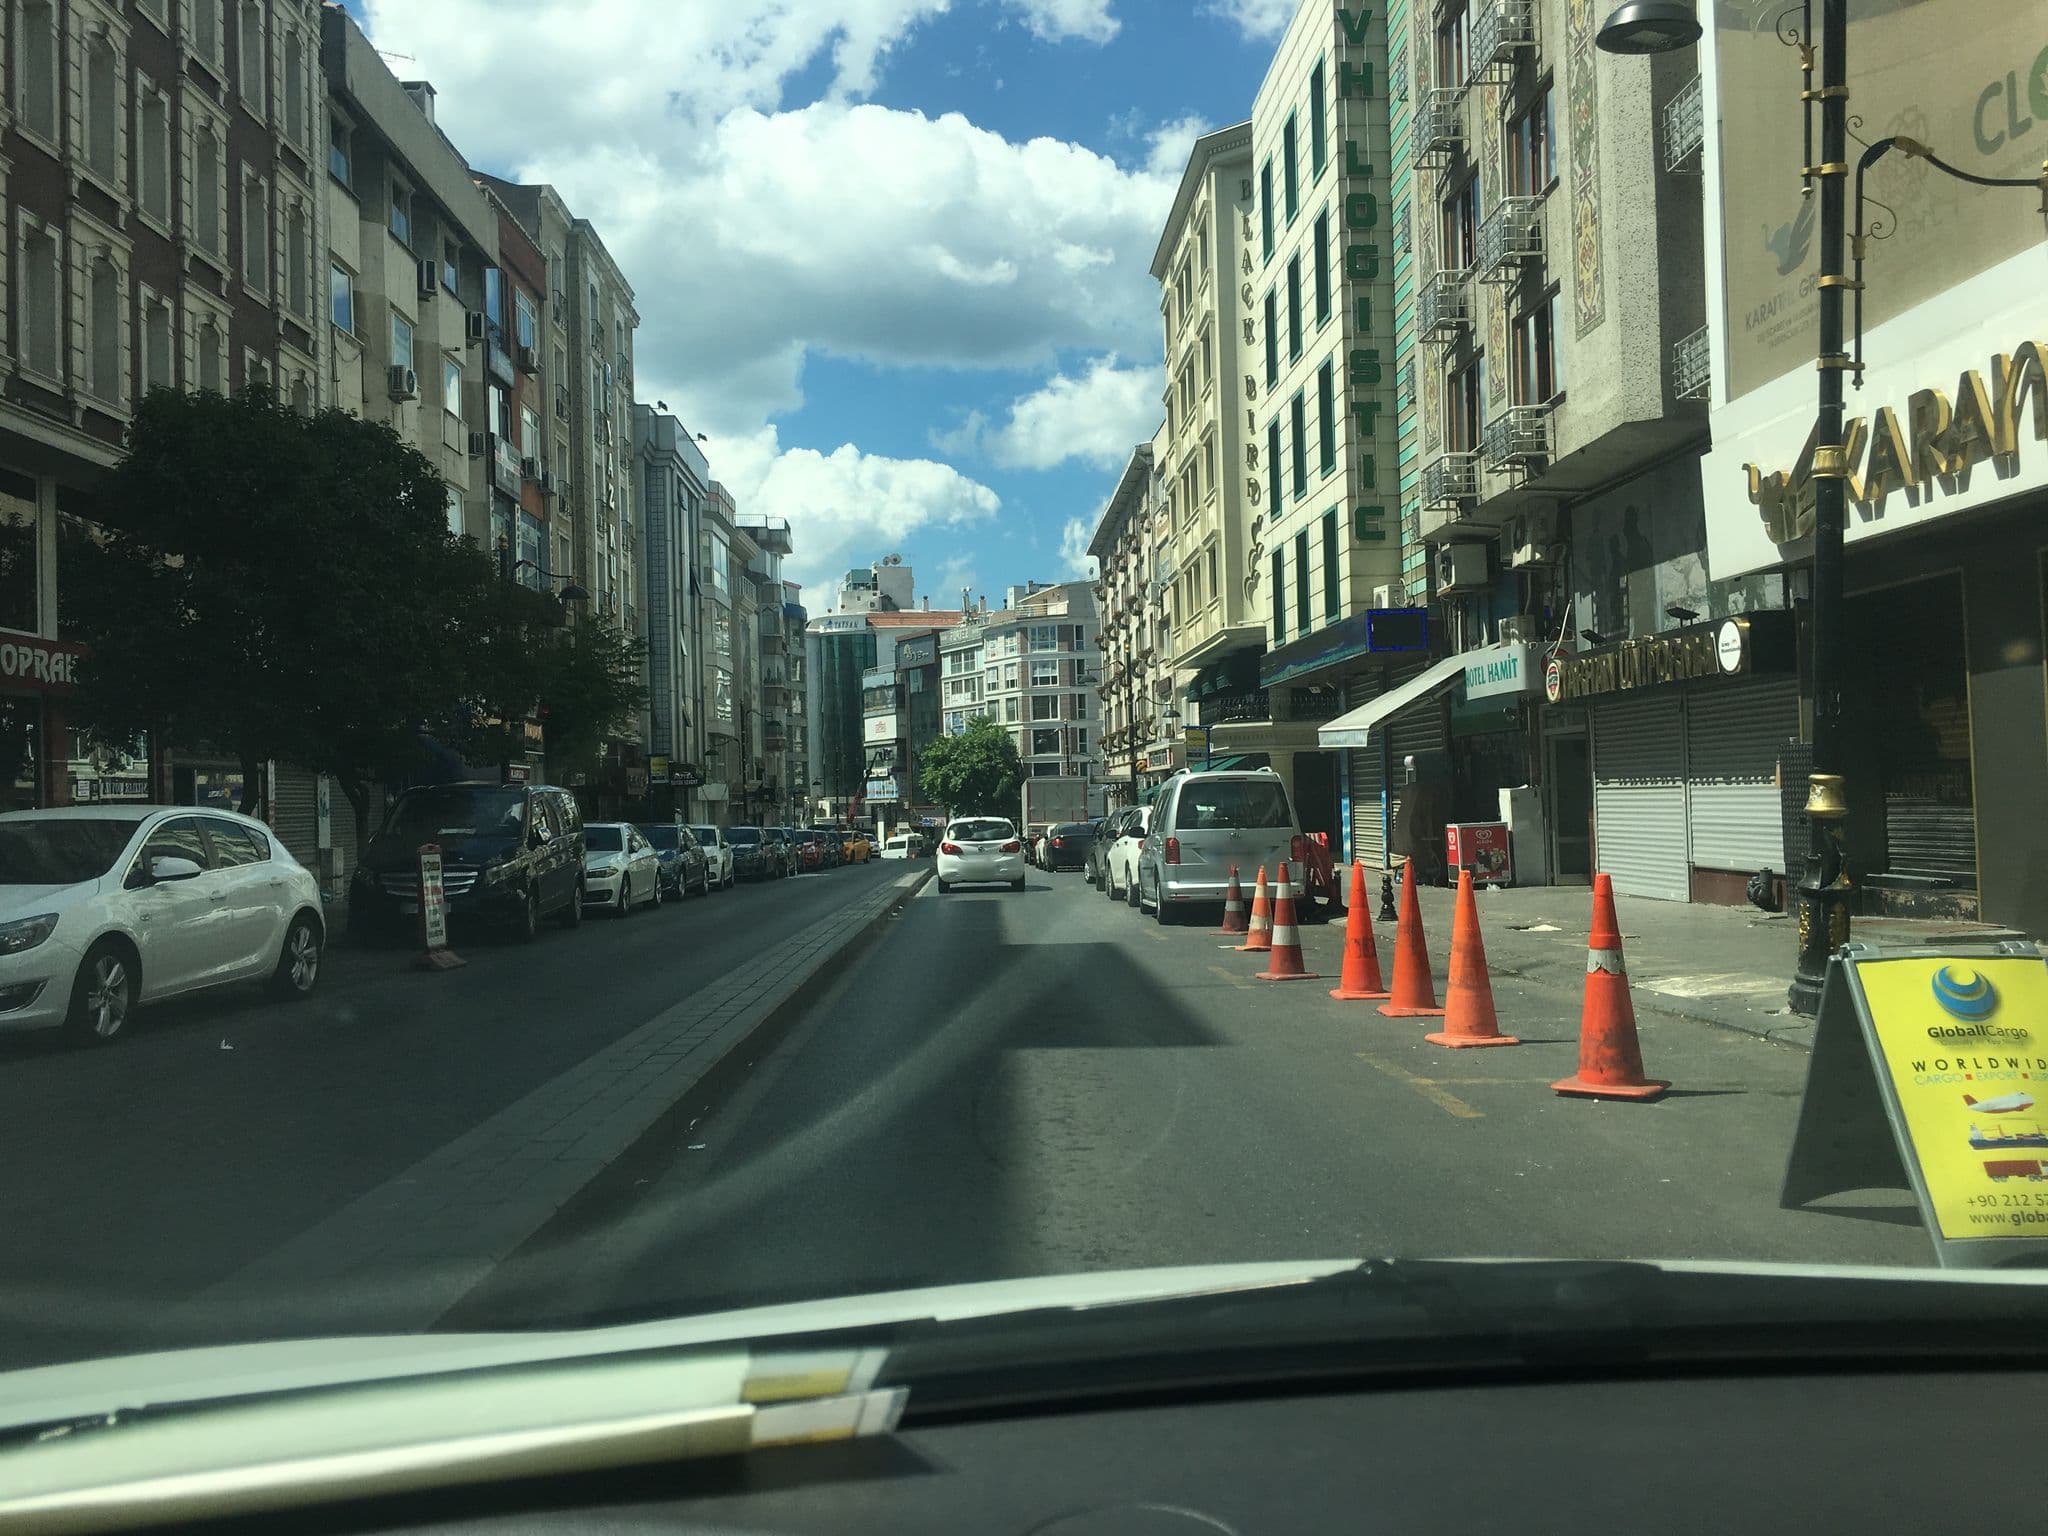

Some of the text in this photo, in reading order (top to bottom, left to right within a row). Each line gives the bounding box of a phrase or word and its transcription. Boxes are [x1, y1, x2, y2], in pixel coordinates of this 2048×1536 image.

[1239, 178, 1261, 507] BLACK BIRD
[1345, 140, 1386, 541] LOGISTIC
[1488, 653, 1518, 683] HAMİT
[1928, 1025, 2028, 1040] GloballCargo
[1914, 1072, 1963, 1085] CARGO
[1976, 1071, 2018, 1081] EXPORT
[1967, 1195, 1997, 1207] +90
[2002, 1194, 2031, 1206] 212
[1969, 1210, 2048, 1226] www.glob
